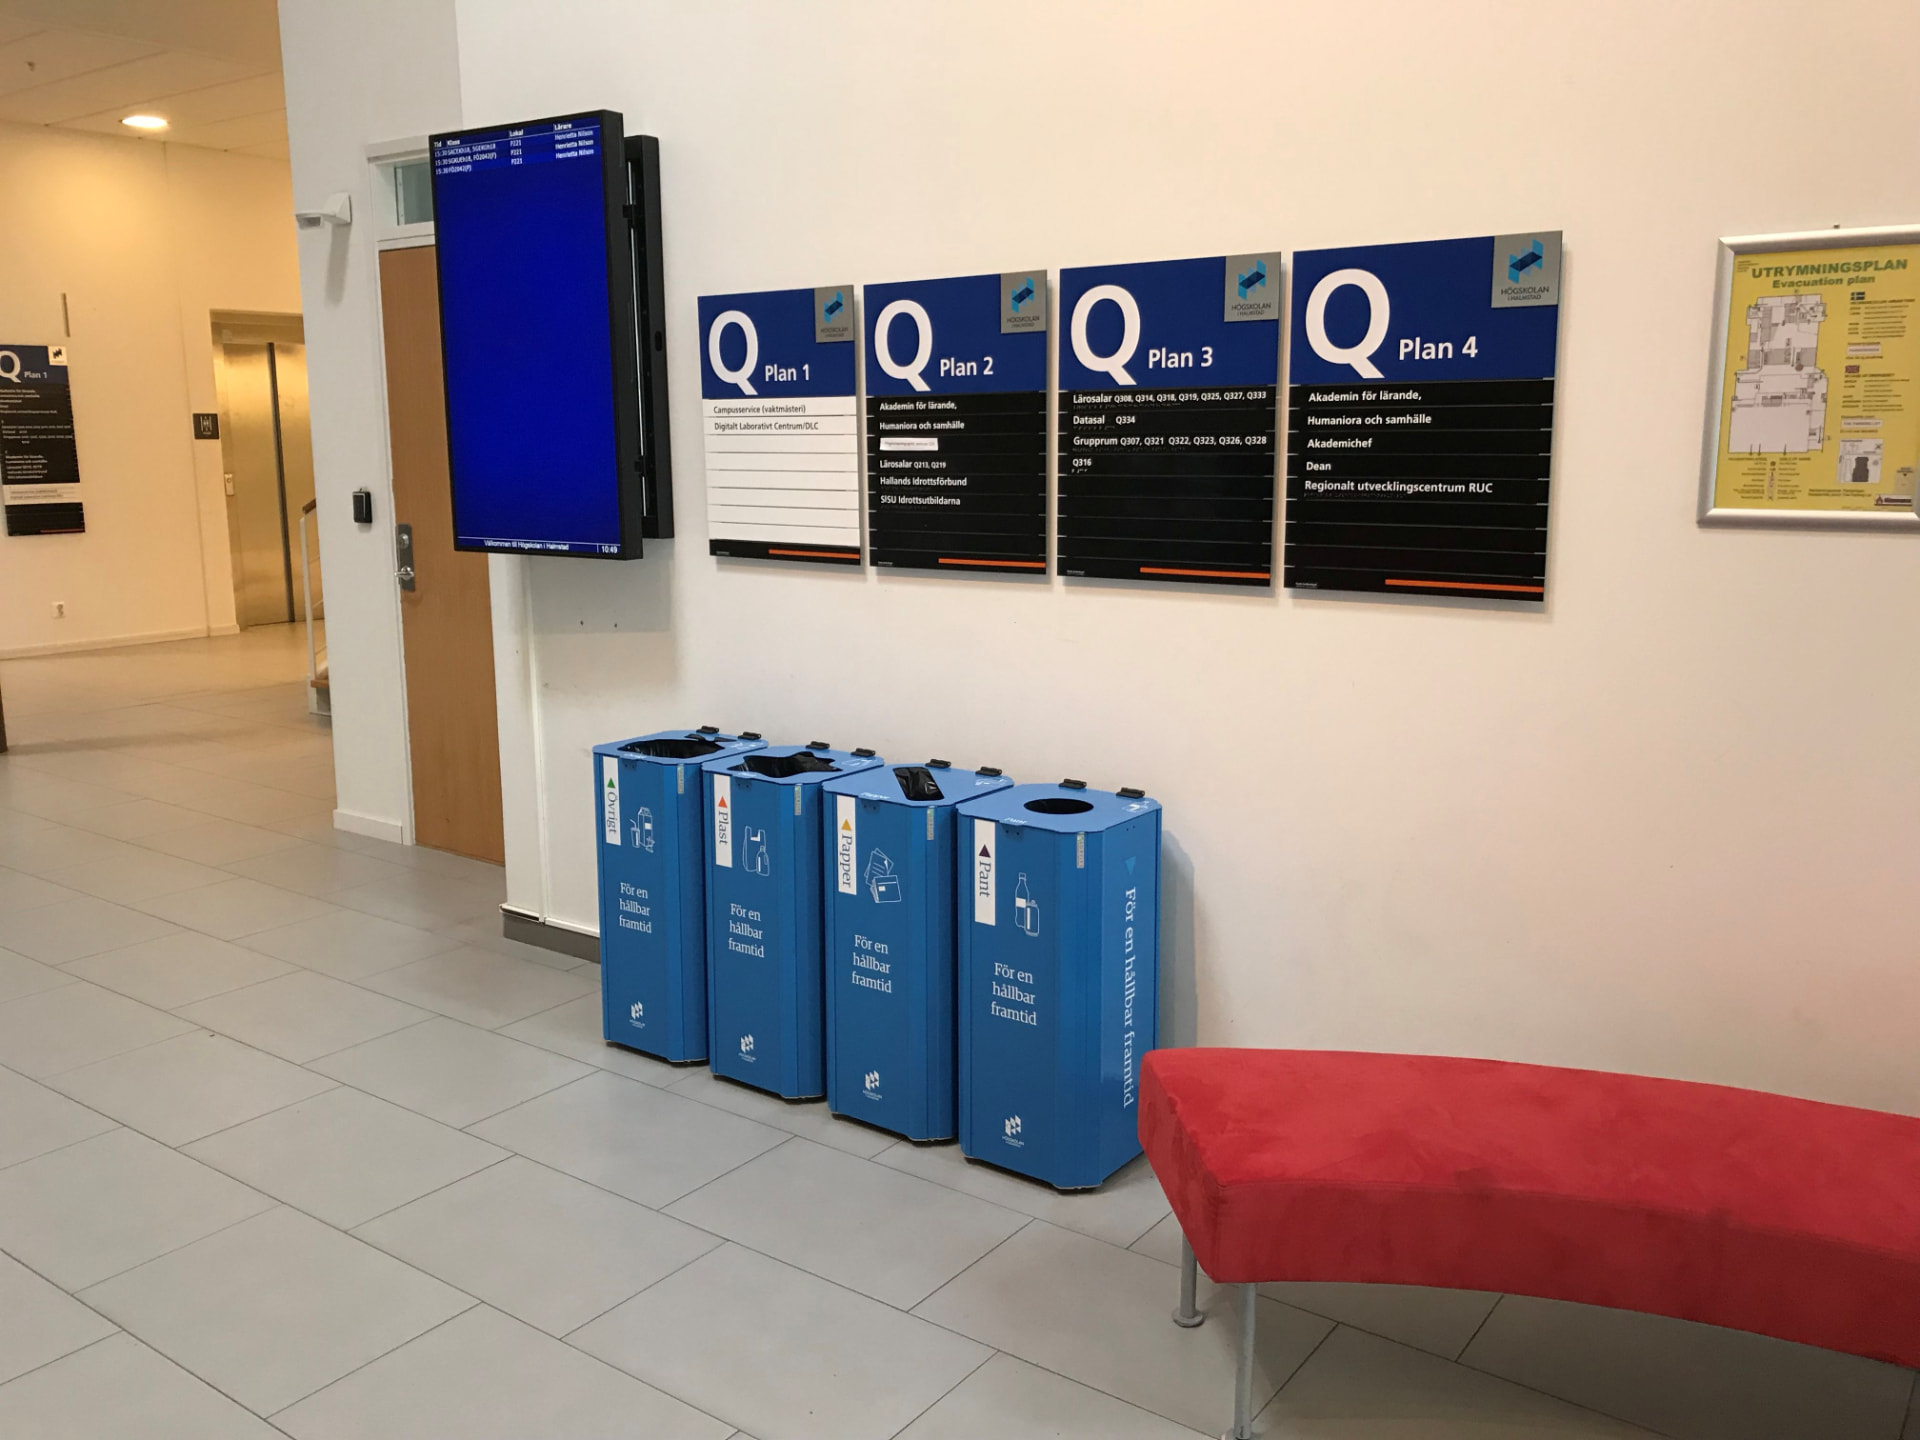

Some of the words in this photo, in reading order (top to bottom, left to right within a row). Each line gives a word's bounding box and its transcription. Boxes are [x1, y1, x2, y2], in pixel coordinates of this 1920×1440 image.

[1752, 258, 1908, 278] UTRYMNINGSPLAN
[1500, 286, 1550, 296] HÖGSKOLAN
[1772, 275, 1843, 288] Evacuation
[1847, 275, 1876, 286] plan
[1231, 302, 1272, 311] HÖGSKOLAN
[1305, 268, 1391, 378] Q
[1399, 337, 1453, 361] Plan
[1461, 336, 1478, 358] 4
[1070, 284, 1141, 386] Q
[1148, 348, 1193, 369] Plan
[1201, 346, 1213, 367] 3
[708, 310, 759, 396] Q
[764, 364, 797, 382] Plan
[802, 364, 810, 381] 1
[874, 300, 933, 392] Q
[940, 358, 977, 377] Plan
[983, 356, 994, 375] 2
[0, 350, 22, 383] Q
[880, 402, 914, 411] Akademin
[916, 402, 927, 410] för
[928, 401, 957, 410] lärande,
[1073, 394, 1112, 404] Lärosalar
[1114, 394, 1133, 404] Q308,
[1135, 394, 1155, 403] Q314,
[1157, 393, 1177, 403] Q318,
[1178, 393, 1199, 402] Q319,
[1201, 392, 1222, 402] Q325,
[1223, 392, 1244, 401] Q327,
[1246, 391, 1266, 400] Q333
[1308, 392, 1359, 403] Akademin
[1362, 391, 1377, 401] för
[1380, 390, 1422, 402] lärande,
[713, 405, 760, 414] Campusservice
[762, 404, 806, 414] (vaktmästeri)
[714, 422, 738, 432] Digitalt
[739, 422, 773, 430] Laborativt
[775, 422, 819, 430] Centrum/DLC
[880, 422, 917, 430] Humaniora
[918, 421, 931, 430] och
[933, 420, 965, 430] samhälle
[1073, 415, 1105, 424] Datasal
[1115, 415, 1136, 424] Q334
[1307, 415, 1362, 426] Humaniora
[1364, 415, 1383, 425] och
[1385, 414, 1432, 424] samhälle
[1073, 436, 1118, 447] Grupprum
[1120, 437, 1142, 447] Q307,
[1144, 437, 1164, 446] Q321
[1168, 436, 1191, 446] Q322,
[1193, 436, 1216, 446] Q323,
[1218, 436, 1242, 446] Q326,
[1244, 436, 1267, 445] Q328
[1307, 438, 1373, 449] Akademichef
[880, 460, 912, 469] Lärosalar
[914, 461, 930, 470] Q213,
[931, 461, 946, 470] Q219
[1072, 458, 1092, 467] Q316
[1306, 461, 1332, 471] Dean
[880, 477, 911, 486] Hallands
[912, 477, 967, 486] Idrottsförbund
[1305, 480, 1354, 492] Regionalt
[1357, 480, 1465, 495] utvecklingscentrum
[1469, 482, 1494, 494] RUC
[880, 495, 897, 504] SISU
[898, 496, 961, 505] Idrottsutbildarna
[484, 540, 511, 548] Välkommen
[518, 541, 543, 550] Högskolan
[606, 792, 618, 834] Övrigt
[718, 811, 729, 845] Plast
[840, 835, 854, 887] Papper
[978, 860, 993, 897] Pant
[620, 882, 635, 898] För
[637, 888, 648, 899] en
[619, 898, 651, 917] hållbar
[730, 902, 747, 918] För
[748, 910, 761, 921] en
[1125, 887, 1137, 922] För
[619, 915, 652, 933] framtid
[729, 920, 764, 940] hållbar
[728, 937, 765, 958] framtid
[853, 934, 872, 950] För
[874, 942, 889, 955] en
[1125, 926, 1135, 951] en
[853, 954, 891, 974] hållbar
[993, 962, 1014, 980] För
[1017, 970, 1034, 984] en
[851, 971, 892, 993] framtid
[1124, 952, 1137, 1027] hållbar
[992, 981, 1035, 1006] hållbar
[990, 1000, 1038, 1027] framtid
[1123, 1030, 1136, 1109] framtid
